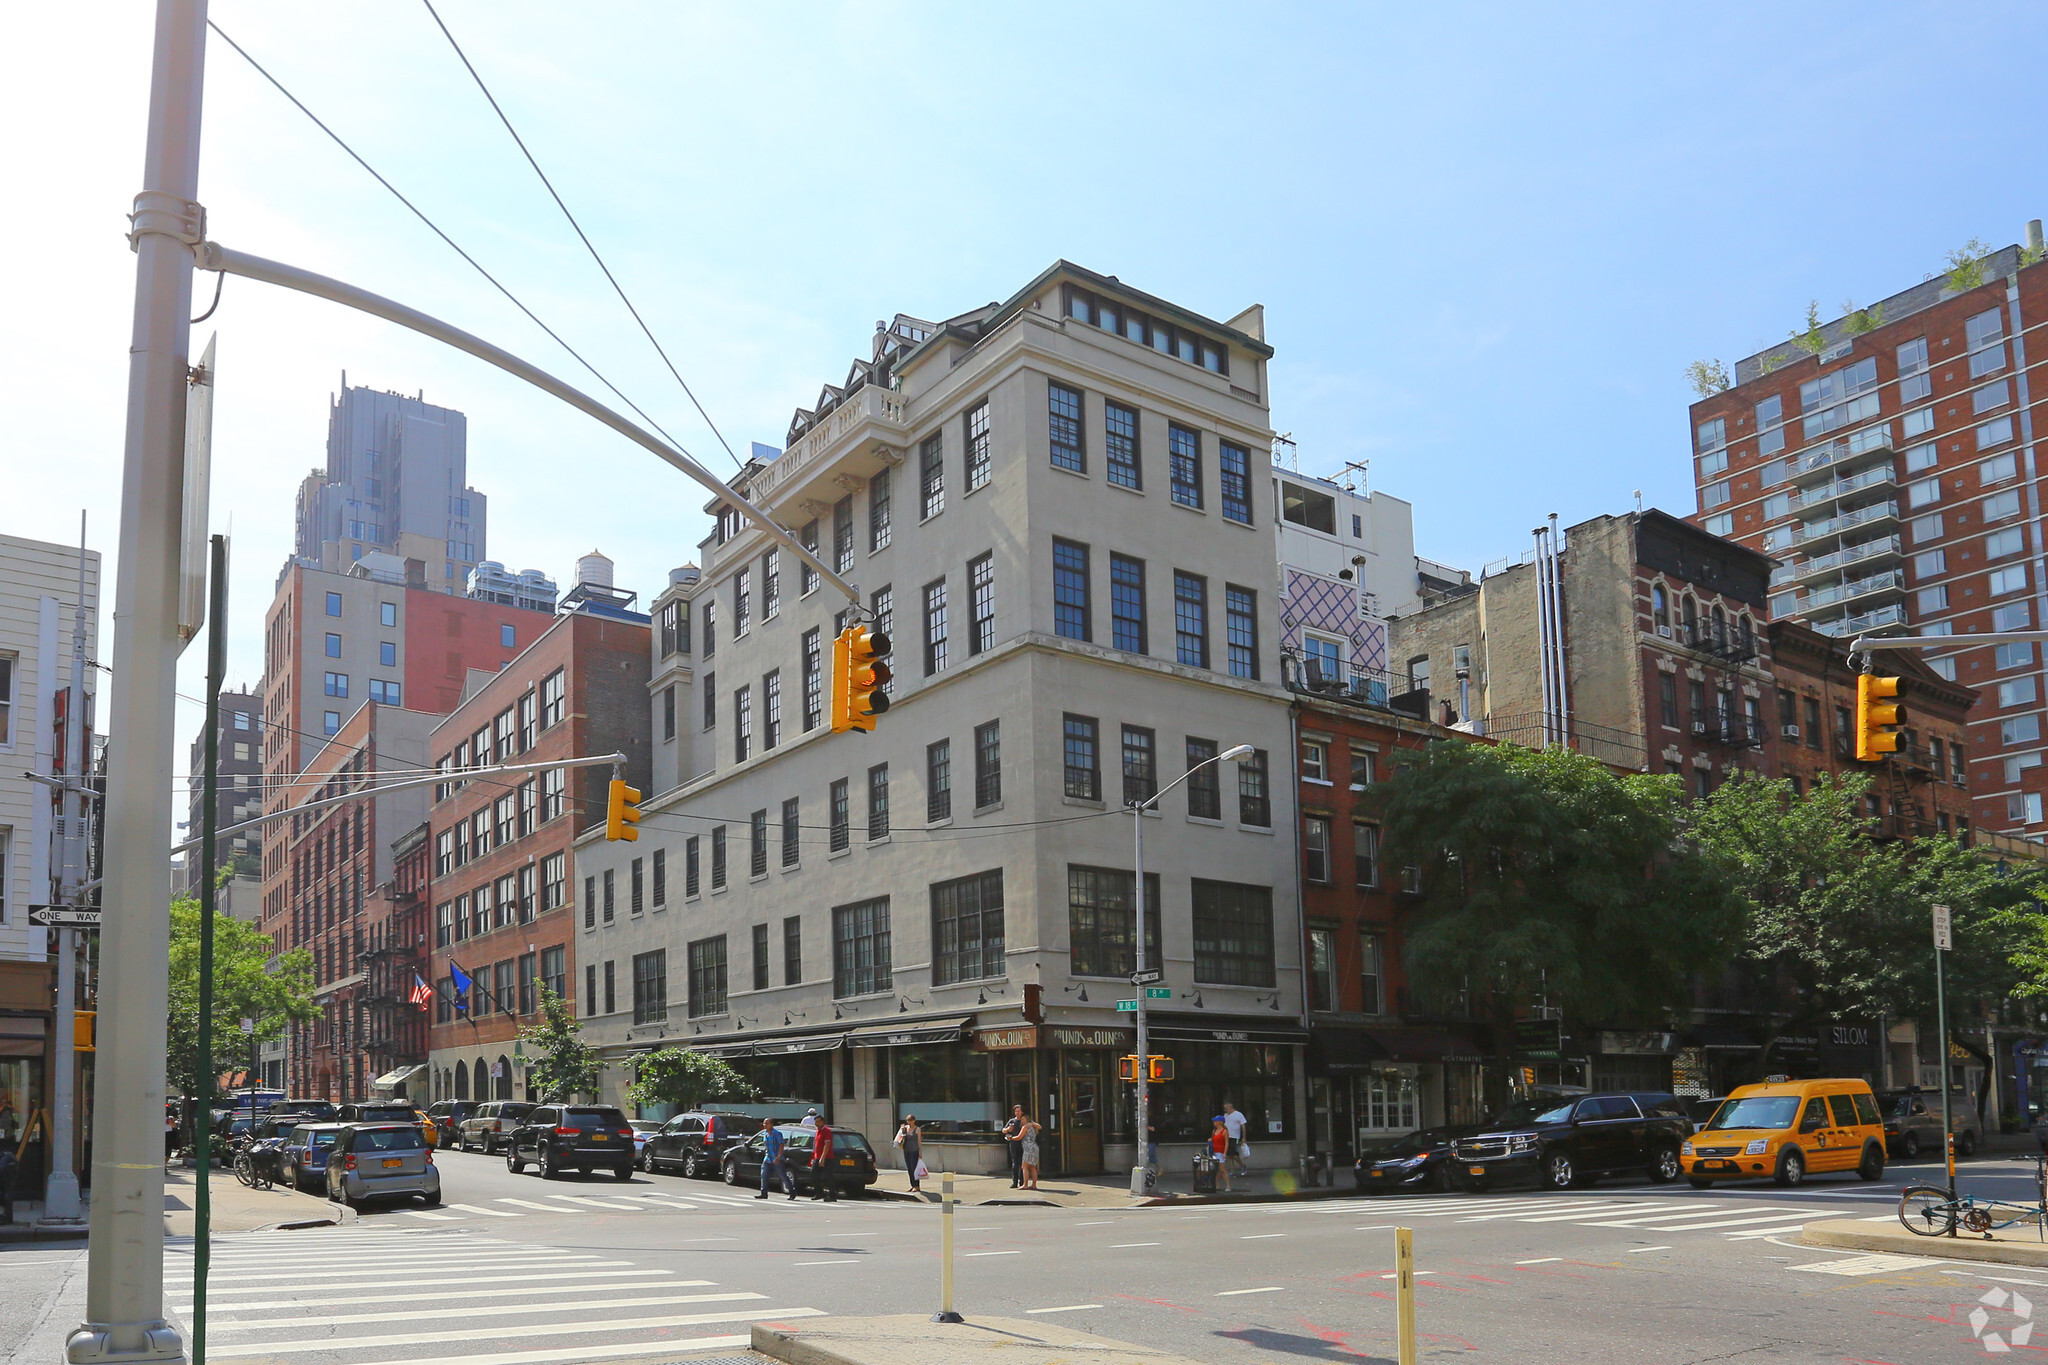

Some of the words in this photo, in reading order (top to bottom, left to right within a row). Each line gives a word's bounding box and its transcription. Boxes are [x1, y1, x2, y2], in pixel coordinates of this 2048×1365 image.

[39, 911, 61, 921] ONE
[76, 912, 98, 921] WAY
[1152, 989, 1158, 998] 8
[1125, 1001, 1132, 1010] 18
[1833, 1026, 1868, 1045] SILOM
